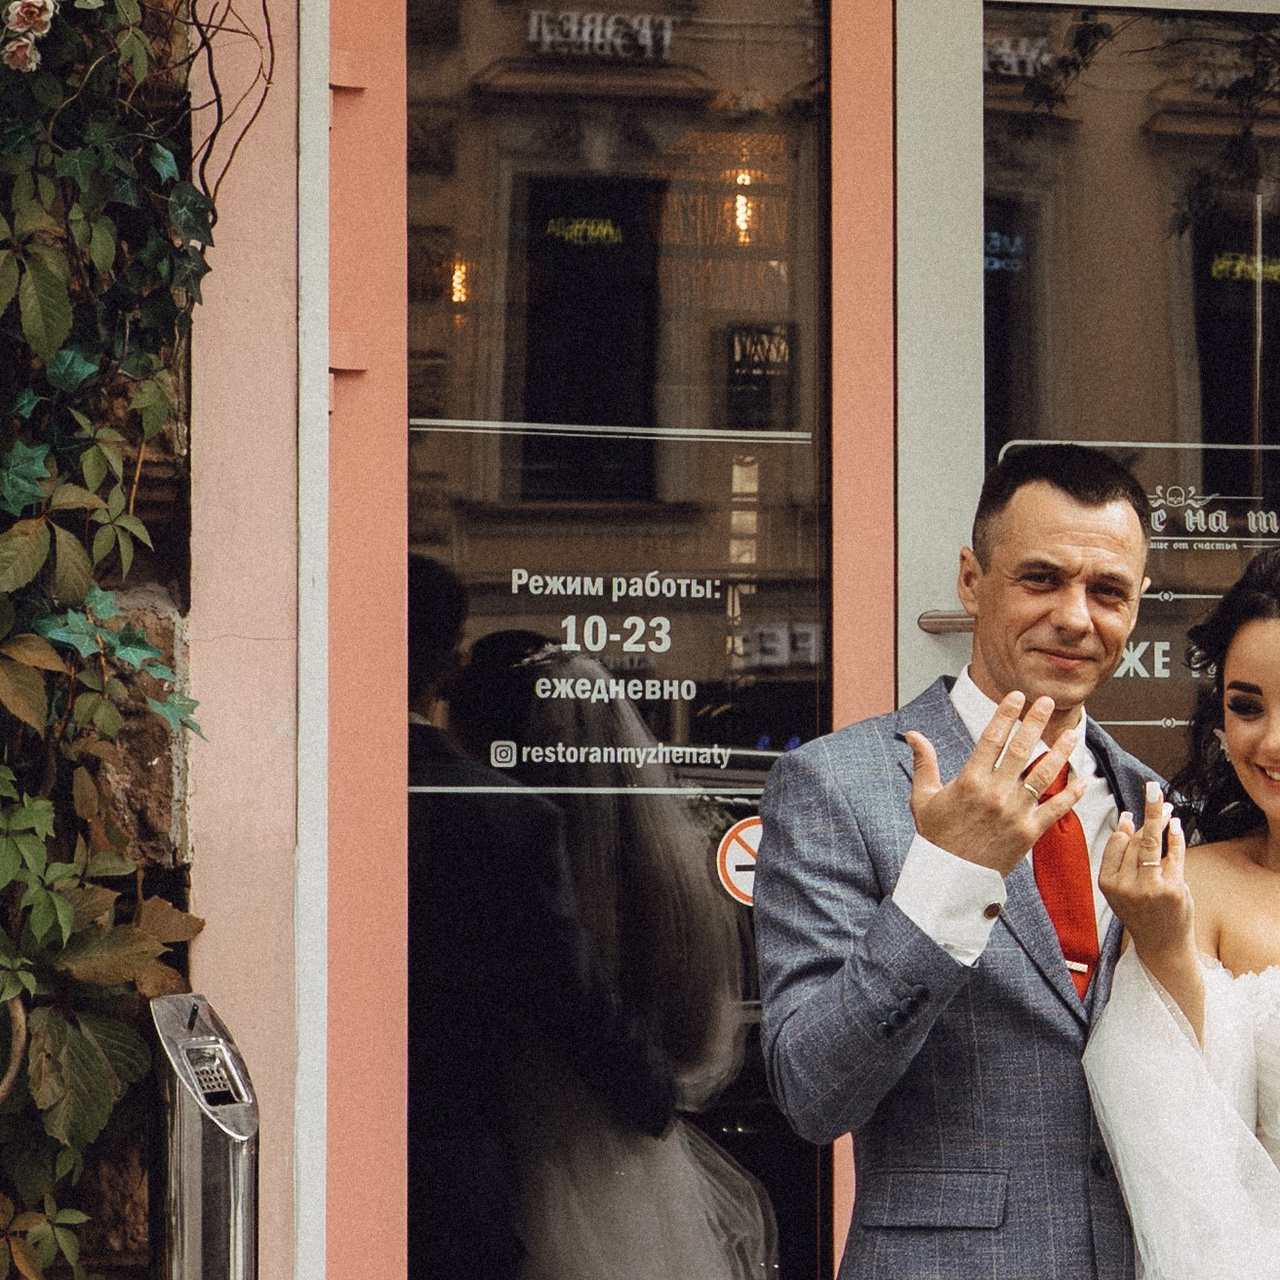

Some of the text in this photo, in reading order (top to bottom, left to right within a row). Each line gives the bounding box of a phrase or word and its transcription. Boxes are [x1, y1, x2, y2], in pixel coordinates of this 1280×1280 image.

[1183, 508, 1230, 534] на
[511, 568, 722, 602] Режим работы:
[560, 614, 673, 654] 10-23
[535, 676, 698, 703] ежедневно
[521, 742, 732, 770] restoranmyzhenaty
